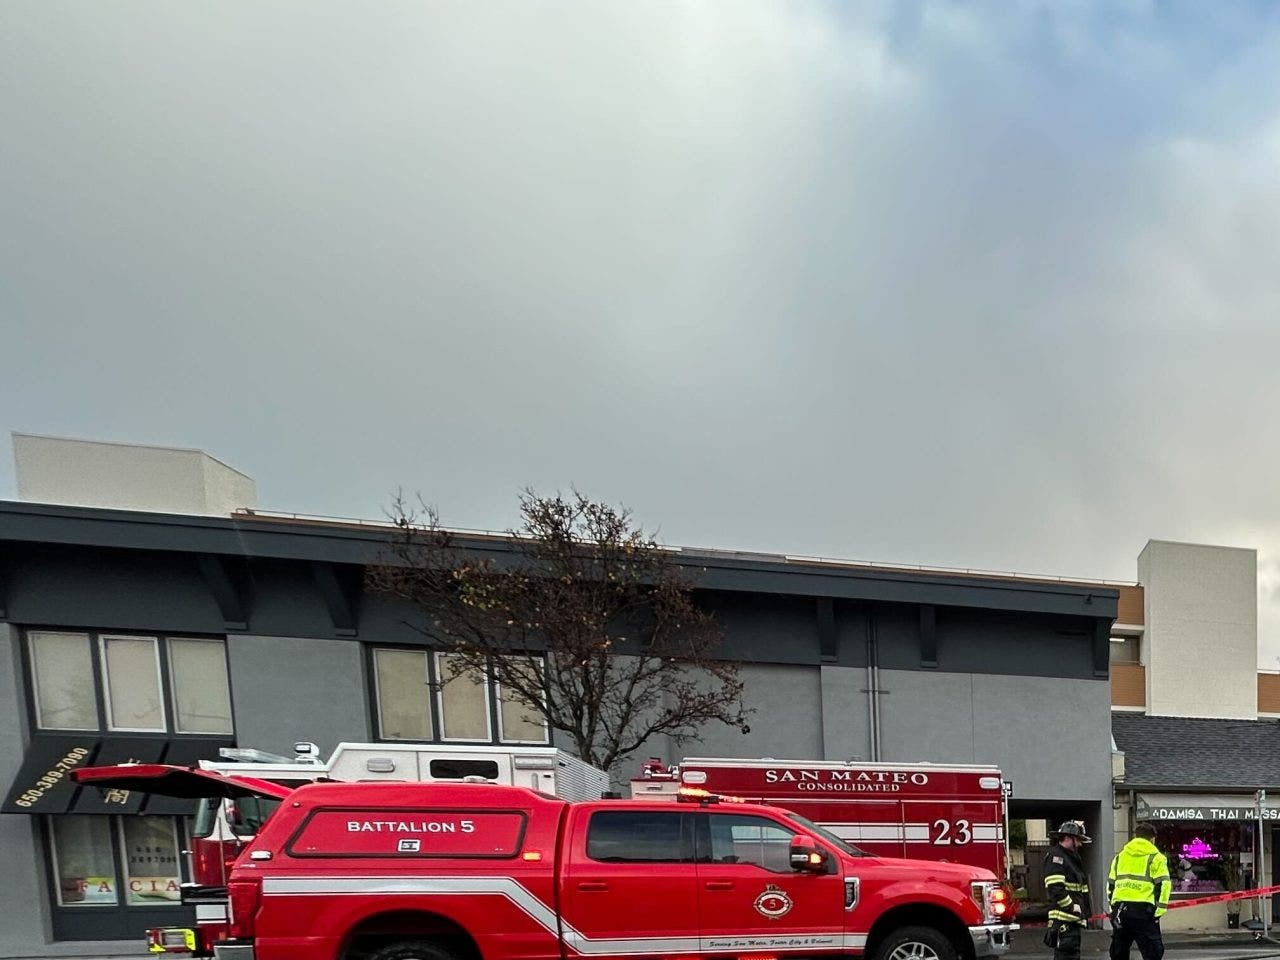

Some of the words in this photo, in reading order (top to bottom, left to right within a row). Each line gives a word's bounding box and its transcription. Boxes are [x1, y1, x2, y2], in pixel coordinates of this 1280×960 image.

[15, 747, 89, 808] 650-389-7090
[766, 770, 819, 783] SAN
[831, 771, 929, 786] MATEO
[797, 782, 900, 792] CONSOLIDATED
[1159, 808, 1204, 819] DAMISA
[1210, 808, 1239, 819] THAI
[347, 821, 456, 833] BATTALION
[461, 820, 475, 833] 5
[932, 818, 973, 845] 23
